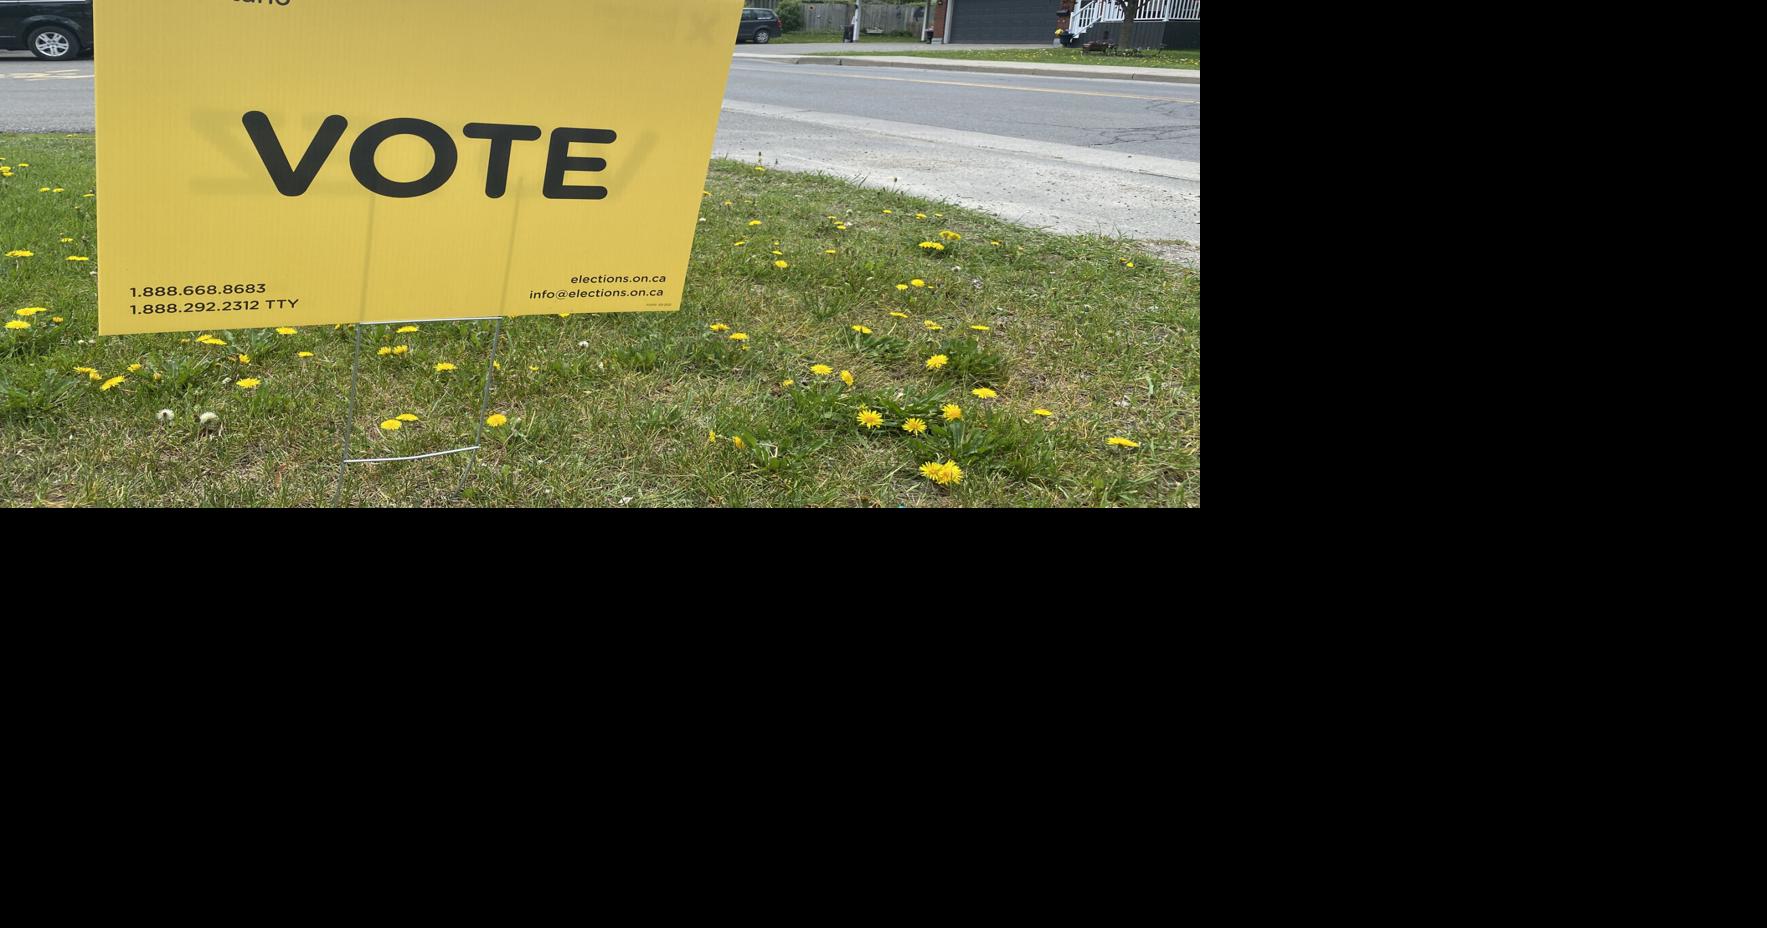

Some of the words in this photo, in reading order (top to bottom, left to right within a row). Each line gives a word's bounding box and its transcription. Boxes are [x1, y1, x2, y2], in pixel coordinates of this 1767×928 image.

[241, 110, 618, 200] VOTE
[570, 274, 667, 284] elections.on.ca
[129, 283, 267, 298] 1.888.668.8683
[529, 288, 664, 300] info@elections.on.ca
[129, 299, 260, 315] 1.888.292.2312
[265, 299, 299, 310] TTY
